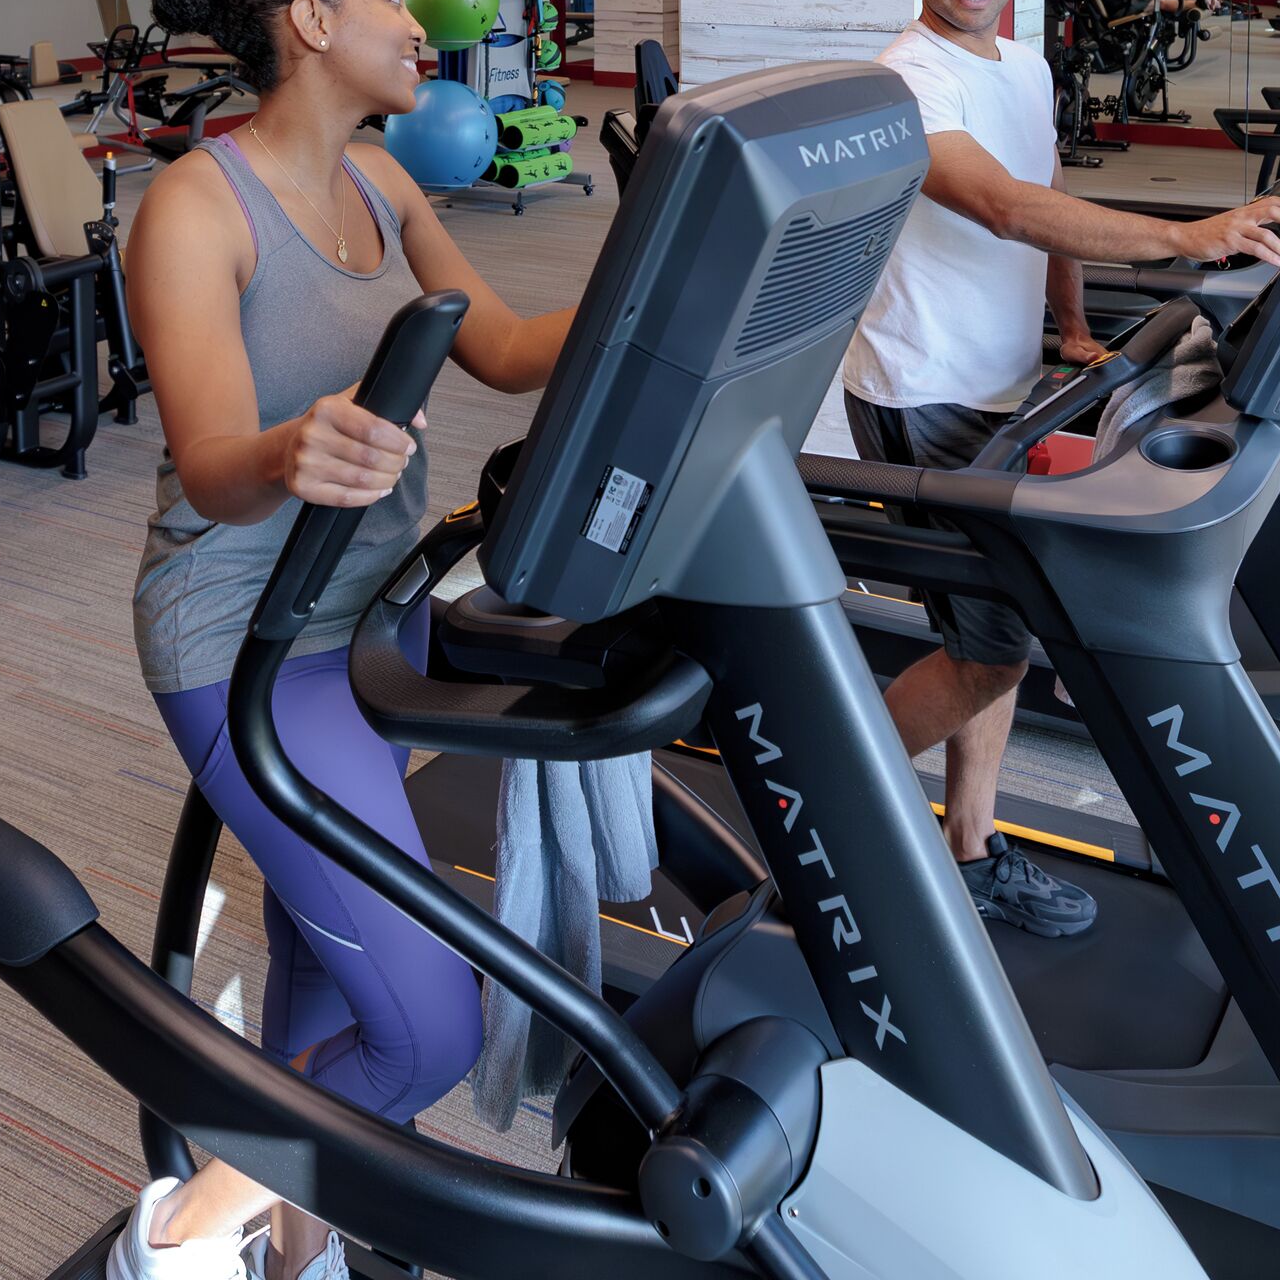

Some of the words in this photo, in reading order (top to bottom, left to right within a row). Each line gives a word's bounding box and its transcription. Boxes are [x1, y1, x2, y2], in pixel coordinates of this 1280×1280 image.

[489, 67, 520, 83] Fitness
[799, 117, 912, 168] MATRIX
[735, 702, 907, 1051] MATRIX
